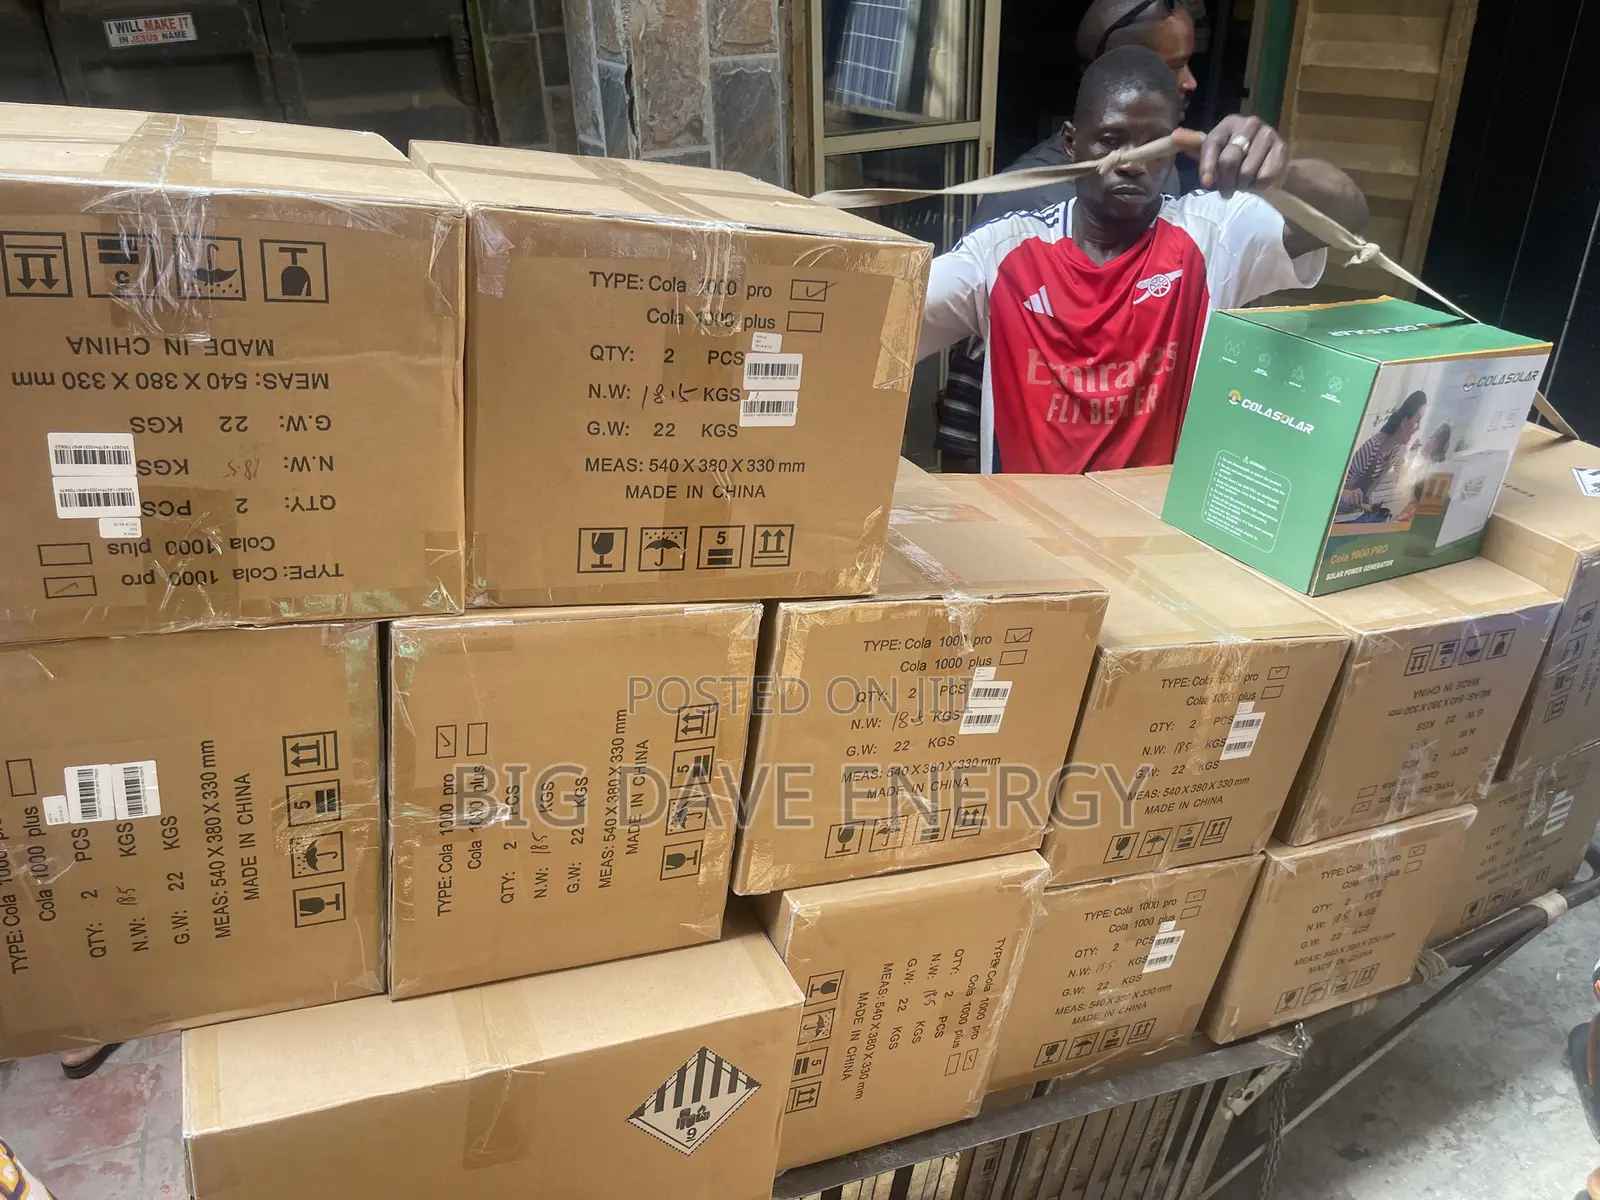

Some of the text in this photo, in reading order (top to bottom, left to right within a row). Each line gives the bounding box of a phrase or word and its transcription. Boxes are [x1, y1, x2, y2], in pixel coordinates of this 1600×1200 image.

[107, 17, 189, 35] I WILL MAKE IT
[118, 30, 187, 44] IN JESUS NAME
[589, 271, 644, 291] TYPE:
[648, 274, 687, 293] Cola
[746, 284, 773, 301] pro
[646, 308, 686, 326] Cola
[744, 313, 776, 332] plus
[65, 336, 275, 357] MADE IN CHINA
[589, 344, 745, 366] QTY: 2 PCS
[1026, 341, 1179, 394] Emirates
[11, 372, 56, 387] mm
[62, 371, 105, 391] 330
[136, 371, 176, 391] 380
[207, 371, 248, 391] 540
[256, 372, 330, 391] MEAS:
[1476, 369, 1540, 388] COLASOLAR
[588, 383, 631, 400] N.W:
[703, 387, 741, 402] KGS
[1046, 393, 1081, 424] FLY
[1240, 397, 1315, 435] COLASOLAR
[129, 415, 332, 435] G.W: 22 KGS
[587, 421, 739, 438] G.W: 22 KGS
[137, 458, 190, 477] KGS
[283, 456, 334, 473] N.W:
[585, 458, 644, 473] MEAS:
[648, 458, 679, 473] 540
[698, 459, 728, 474] 380
[746, 459, 776, 473] 330
[778, 460, 806, 474] mm
[625, 485, 767, 499] MADE IN CHINA
[141, 495, 336, 518] QTY: 2 PCS
[107, 536, 276, 558] Cola 1000 plus
[716, 530, 727, 546] 5
[1330, 544, 1389, 565] Cola 1000 PRO
[120, 563, 344, 588] TYPE: Cola 1000 pro
[1325, 559, 1394, 581] SOLAR POWER GENERATOR
[863, 635, 993, 652] TYPE: Cola pro
[900, 656, 992, 673] Cola 1000 plus
[1161, 673, 1259, 689] TYPE: pro
[855, 684, 967, 703] QTY: 2 PCS
[1186, 692, 1257, 706] Cola plus
[850, 709, 960, 730] N.W: KGS
[1149, 715, 1234, 733] QTY: PCS
[846, 736, 956, 757] G.W: 22 KGS
[1141, 745, 1167, 756] N.W:
[1171, 764, 1186, 775] 22
[539, 781, 556, 814] KGS
[1144, 795, 1224, 815] MADE IN CHINA
[116, 822, 138, 858] KGS
[232, 772, 260, 901] MADE IN CHINA
[437, 773, 458, 918] TYPE: Cola pro
[22, 805, 57, 922] Cola 1000 plus
[467, 839, 483, 870] Cola
[566, 827, 585, 894] G.W: 22
[160, 815, 191, 945] G.W: 22 KGS
[500, 840, 518, 905] QTY: 2
[71, 827, 107, 959] QTY: 2 PCS
[533, 867, 549, 900] N.W:
[1084, 898, 1178, 922] TYPE: Cola 1000 pro
[129, 916, 149, 953] N.W:
[6, 929, 30, 975] TYPE:
[1074, 943, 1120, 959] QTY: 2
[934, 948, 965, 1039] QTY: PCS
[1061, 974, 1143, 998] G.W: 22 KGS
[888, 958, 918, 1051] G.W: 22 KGS
[840, 991, 870, 1082] MADE CHINA
[686, 1127, 698, 1138] 9
